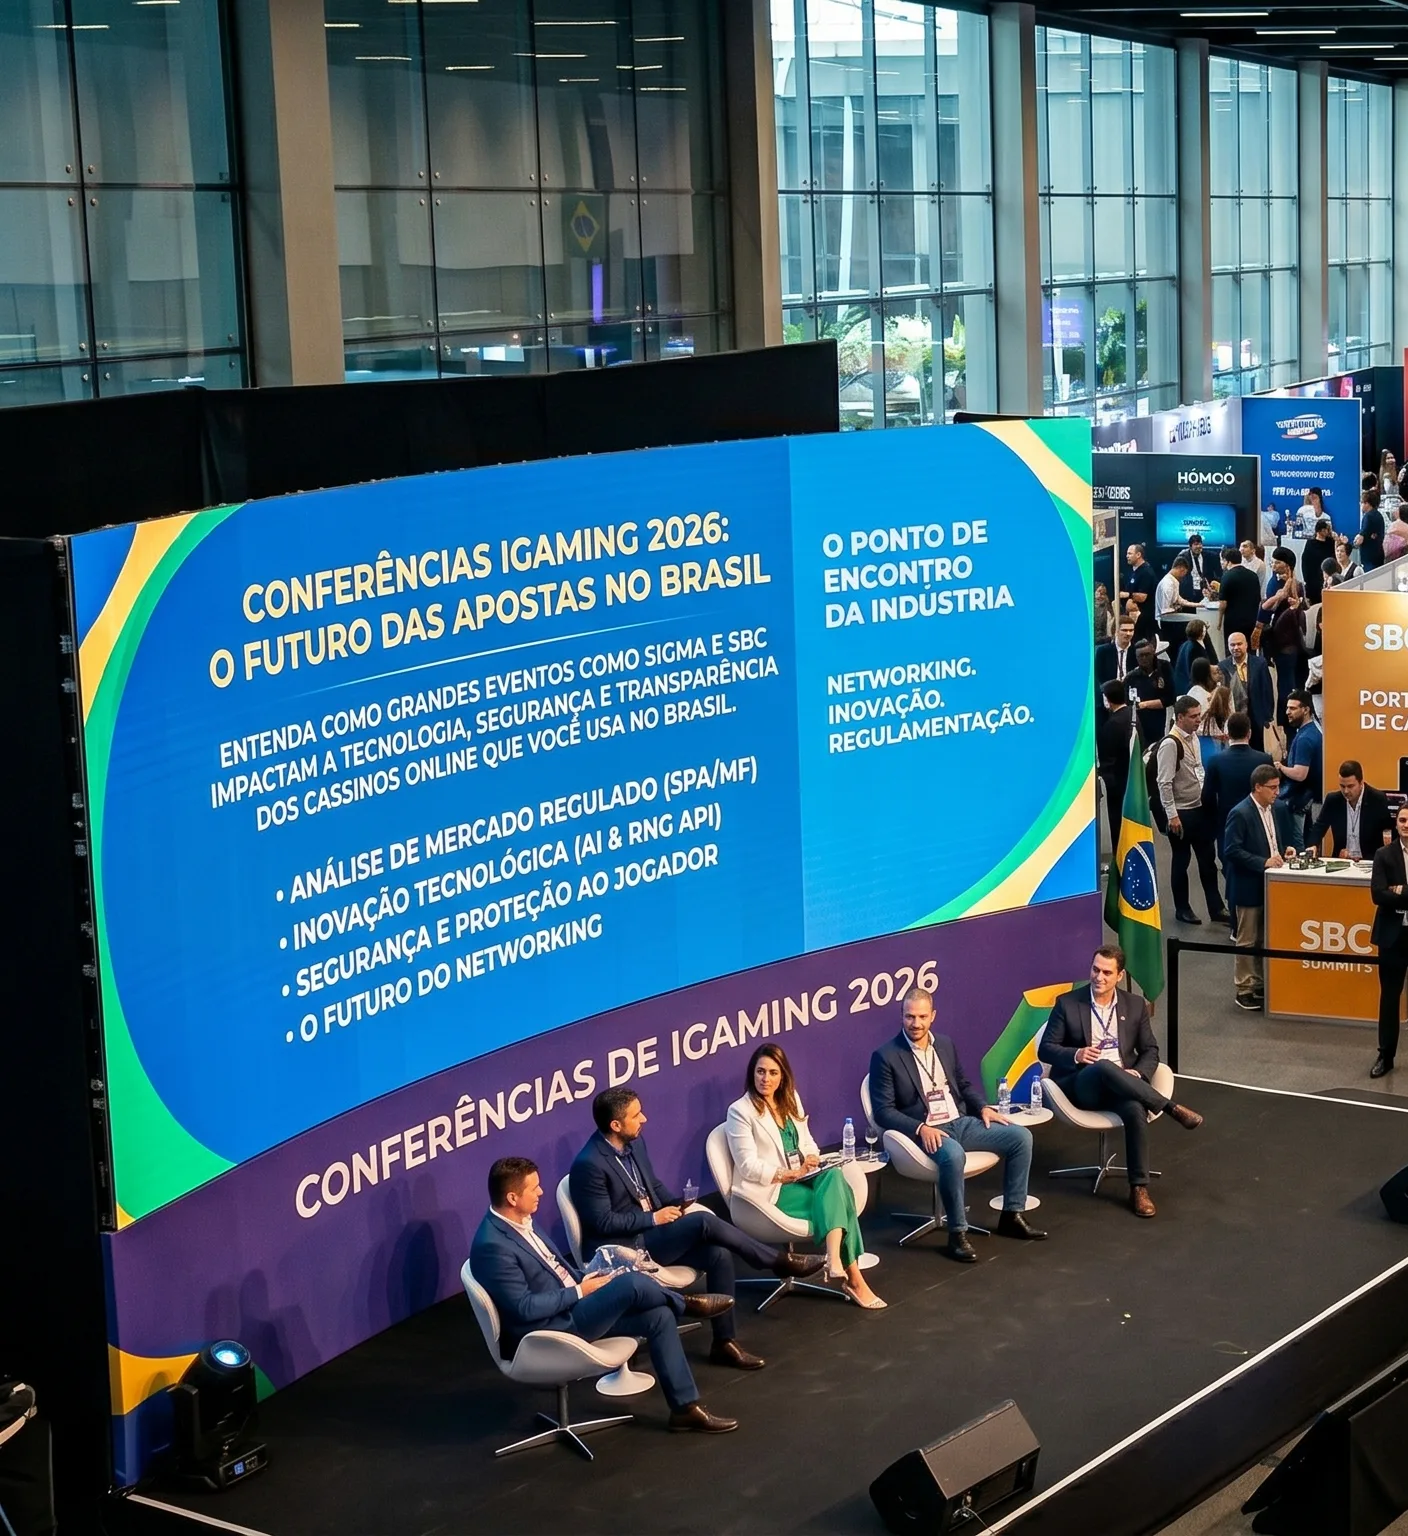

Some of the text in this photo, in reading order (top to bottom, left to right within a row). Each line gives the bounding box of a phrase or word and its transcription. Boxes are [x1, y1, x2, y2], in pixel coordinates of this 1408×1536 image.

[243, 512, 728, 622] CONFERÊNCIAS IGAMING 2026:
[823, 520, 987, 557] O PONTO DE
[825, 556, 972, 592] ENCONTRO
[210, 554, 770, 688] O FUTURO DAS APOSTAS NO BRASIL
[826, 585, 1014, 628] DA INDÚSTRIA
[212, 656, 778, 808] IMPACTAM A TECNOLOGIA, SEGURANÇA E TRANSPARÊNCIA
[221, 626, 768, 768] ENTENDA COMO GRANDES EVENTOS COMO SIGMA E SBC
[828, 658, 976, 694] NETWORKING.
[829, 688, 944, 724] INOVAÇÃO.
[830, 703, 1034, 753] REGULAMENTAÇÃO.
[1360, 713, 1387, 731] DE
[257, 796, 299, 831] DOS
[304, 767, 400, 814] CASSINOS
[406, 747, 477, 785] ONLINE
[483, 736, 523, 768] QUE
[587, 715, 625, 740] USA
[631, 707, 658, 731] NO
[665, 694, 736, 725] BRASIL.
[291, 756, 756, 903] ANÁLISE DE MERCADO REGULADO (SPA/MF)
[294, 803, 721, 950] INOVAÇÃO TECNOLÓGICA (AI & RNG API)
[297, 844, 717, 996] SEGURANÇA E PROTEÇÃO AO JOGADOR
[301, 914, 602, 1041] O FUTURO DO NETWORKING
[1300, 919, 1374, 955] SBC
[296, 961, 938, 1218] CONFERÊNCIAS DE IGAMING 2026
